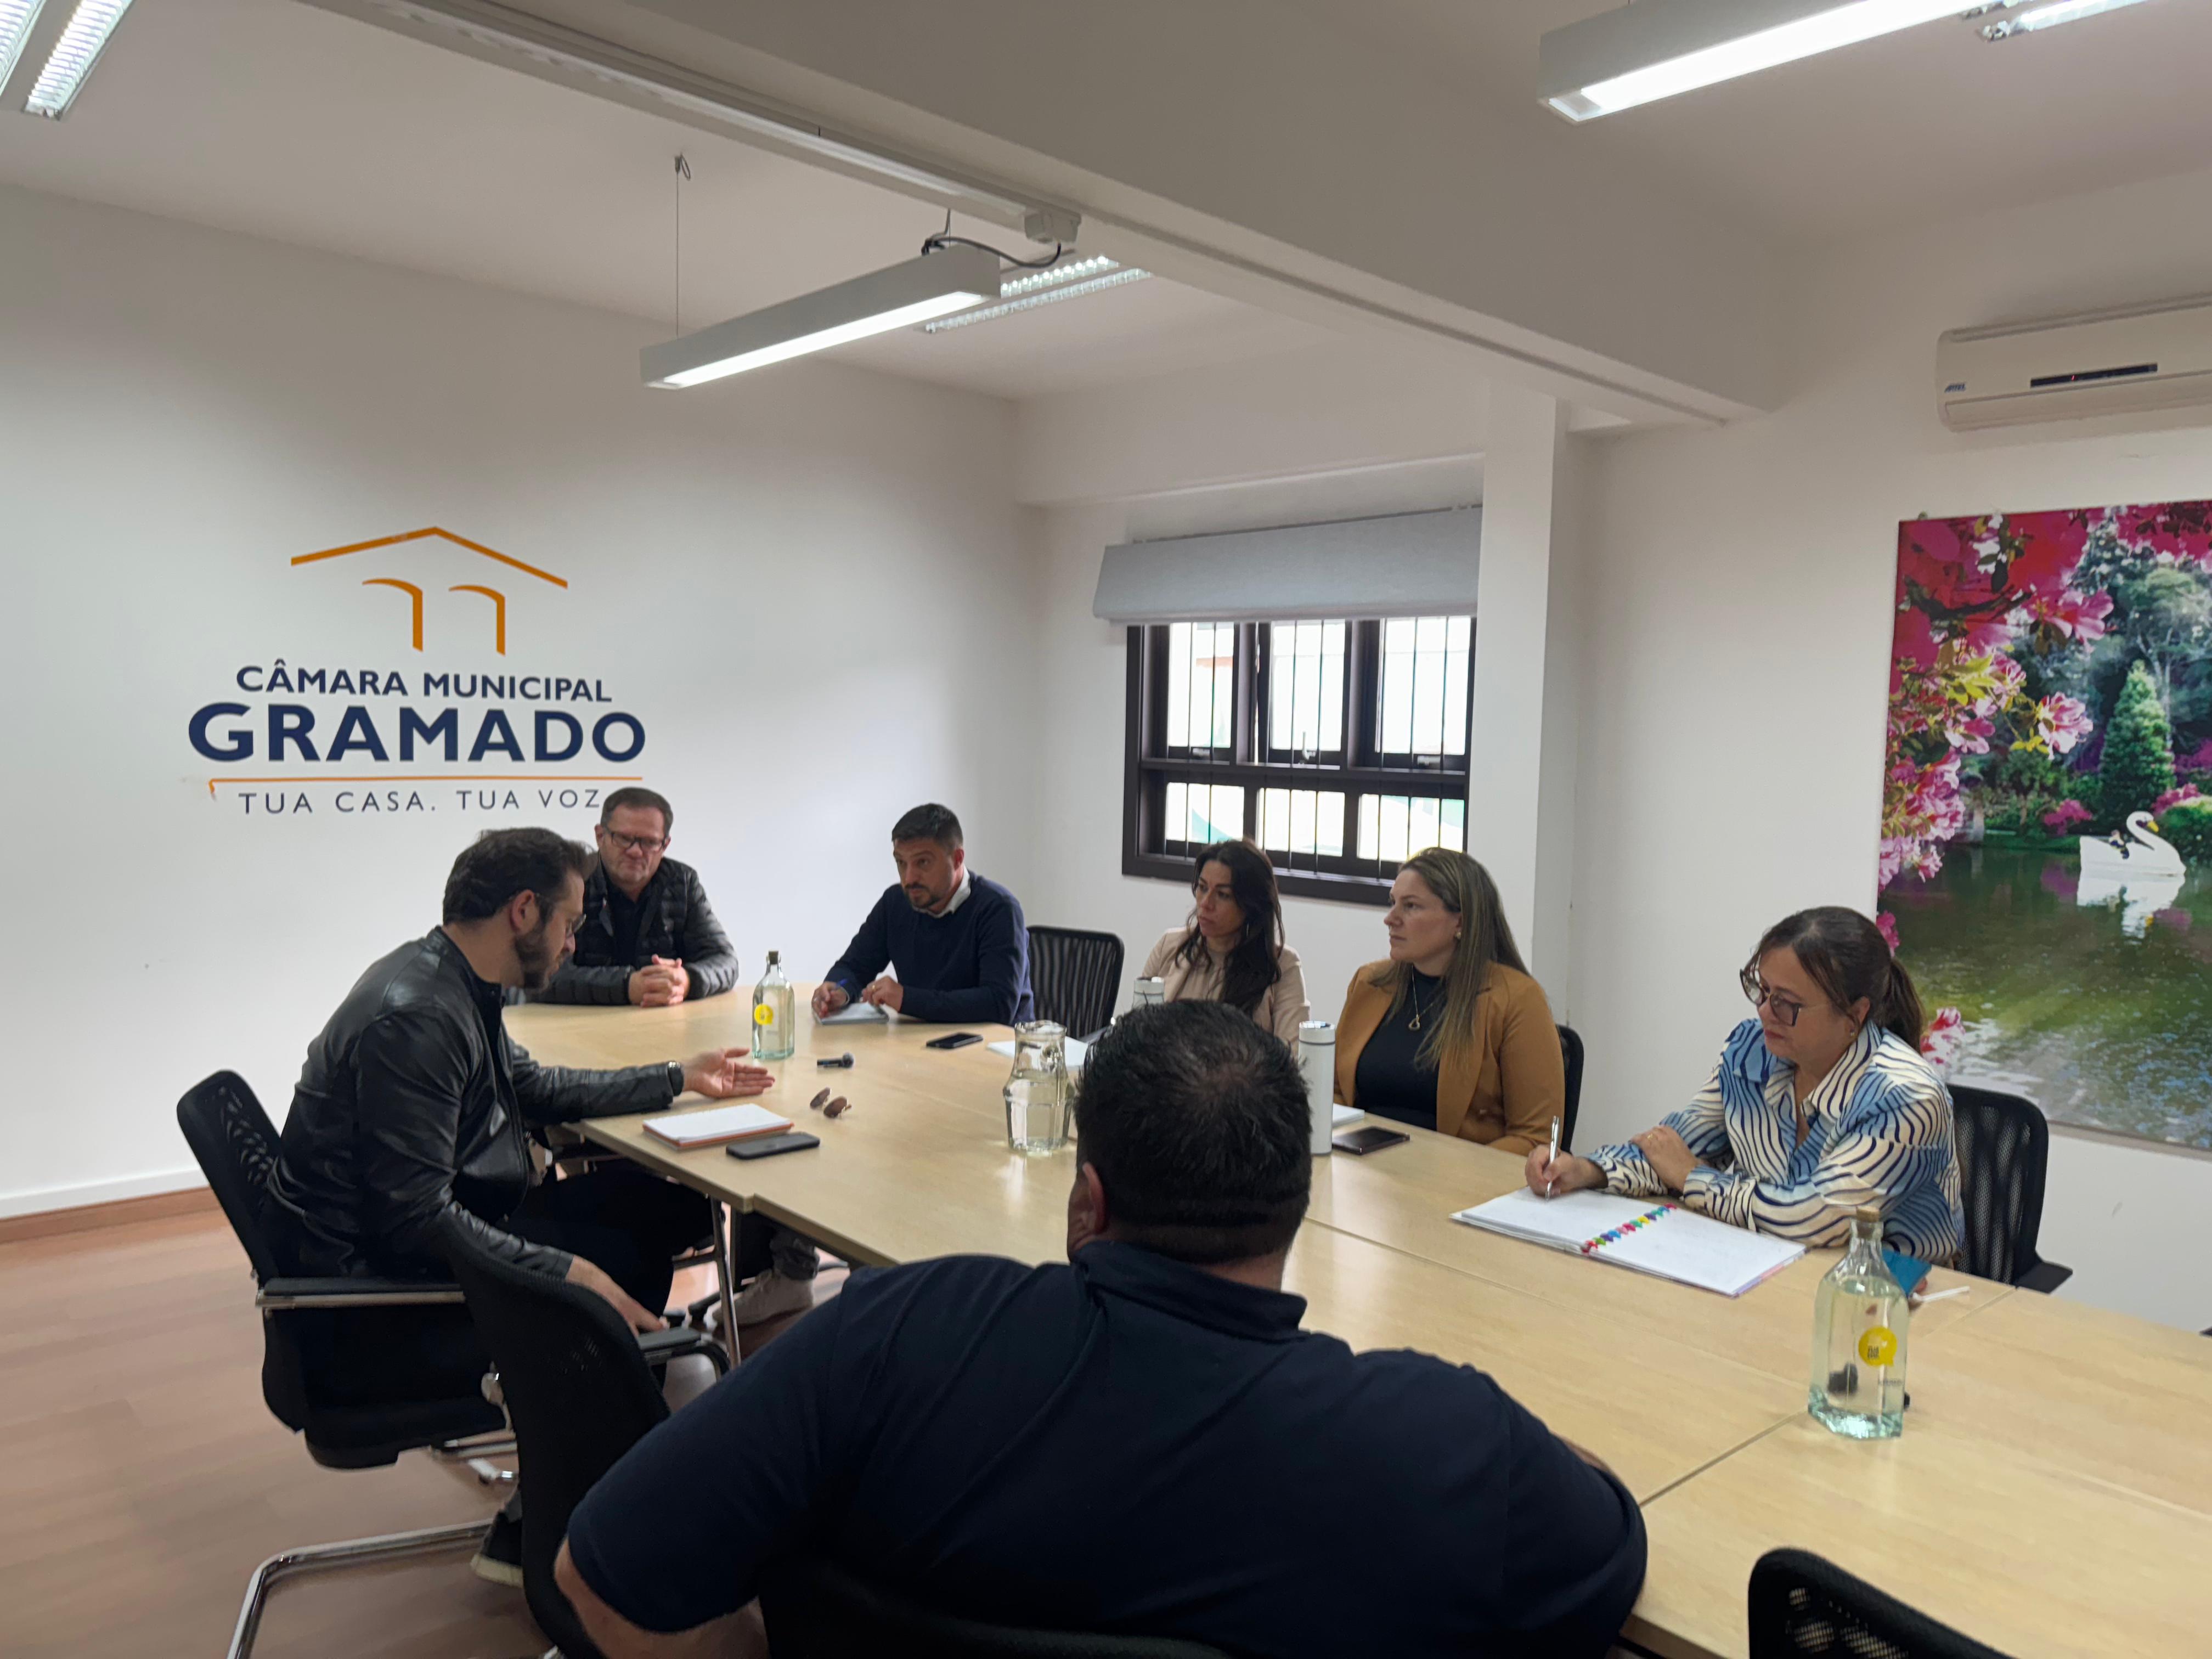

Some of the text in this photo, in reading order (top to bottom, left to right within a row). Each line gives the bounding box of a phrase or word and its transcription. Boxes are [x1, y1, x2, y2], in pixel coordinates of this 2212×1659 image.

[236, 658, 613, 703] CÂMARA MUNICIPAL
[188, 702, 646, 763] GRAMADO
[238, 789, 600, 814] TUA CASA. TUA VOZ
